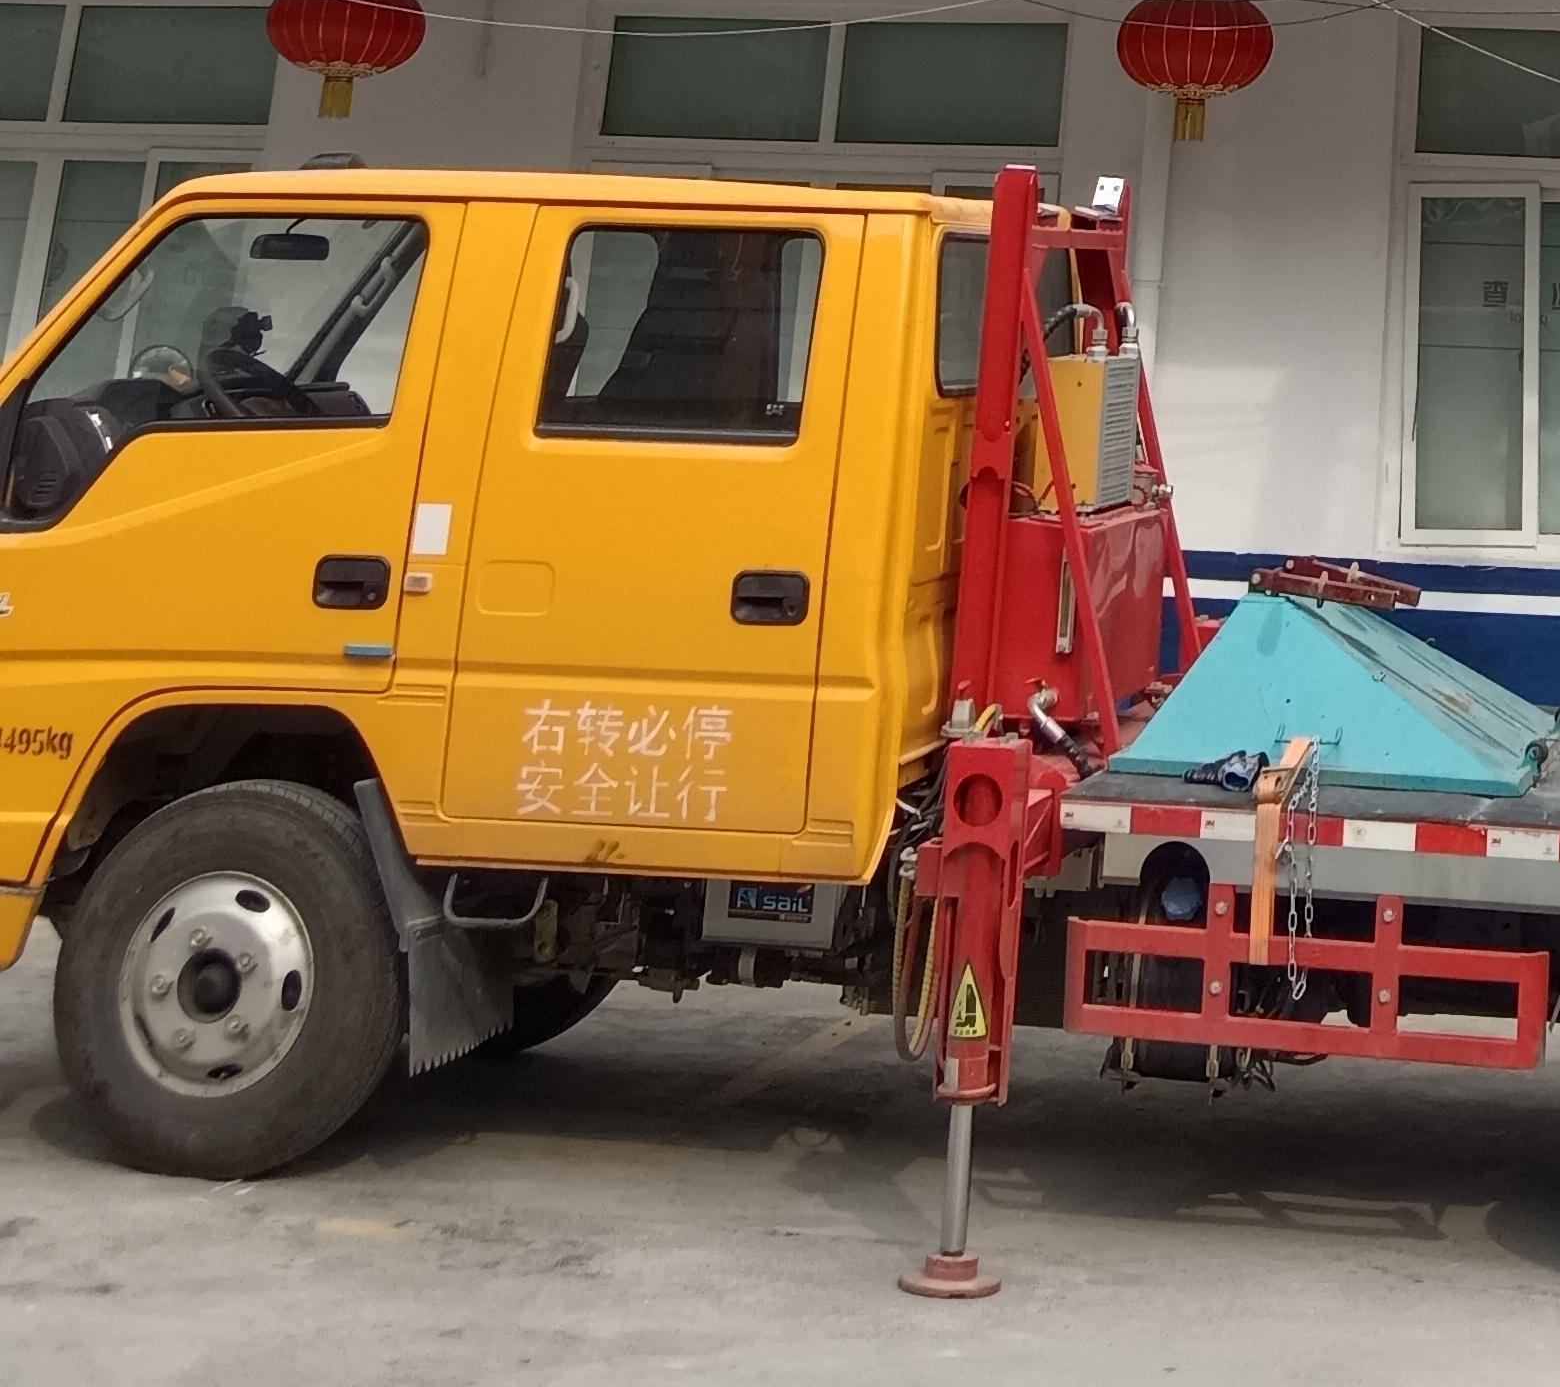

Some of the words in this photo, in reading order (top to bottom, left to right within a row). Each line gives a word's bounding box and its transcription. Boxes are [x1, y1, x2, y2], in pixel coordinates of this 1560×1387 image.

[0, 725, 74, 760] 495kg
[521, 698, 734, 760] 右转必停
[515, 759, 729, 823] 安全让行
